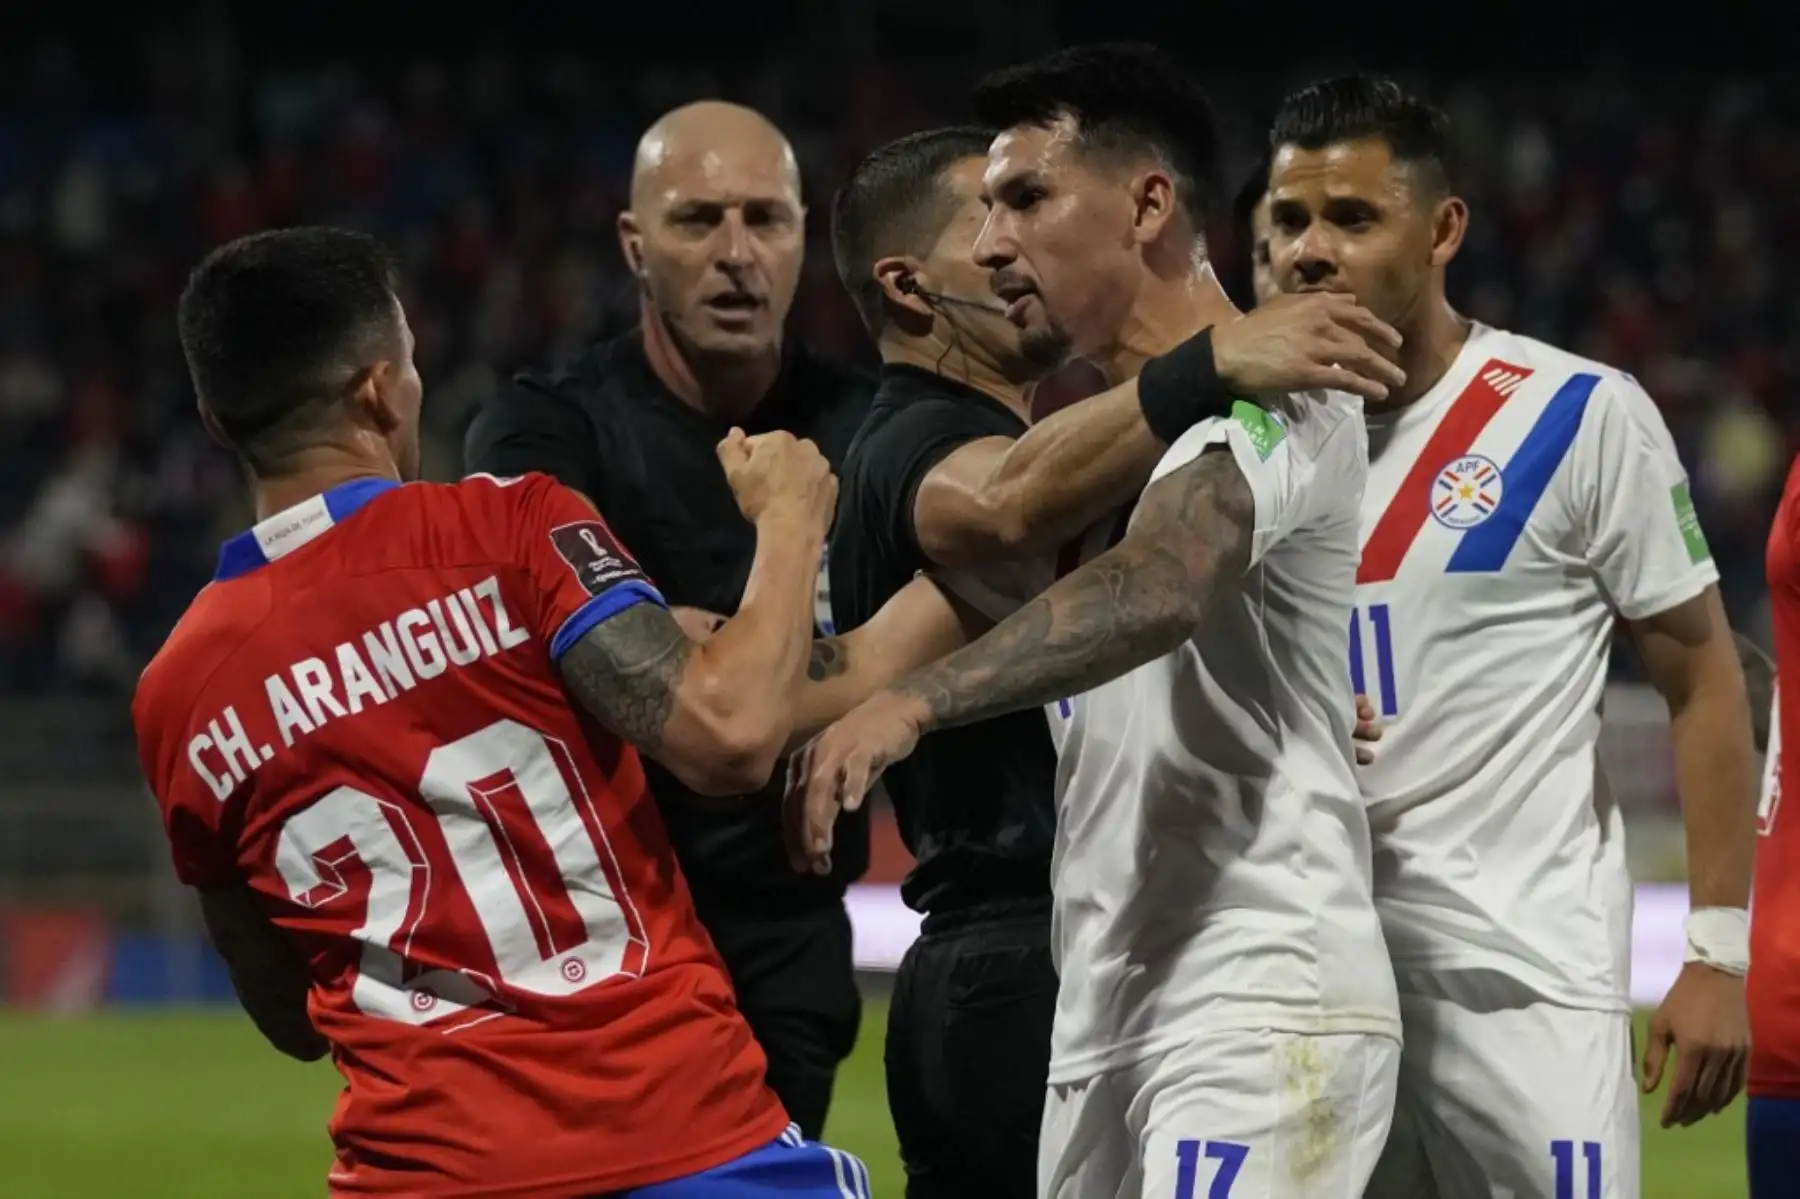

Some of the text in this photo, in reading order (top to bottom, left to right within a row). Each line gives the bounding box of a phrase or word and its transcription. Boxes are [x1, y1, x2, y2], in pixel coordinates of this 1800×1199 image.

[1455, 460, 1480, 474] APF
[187, 575, 530, 802] CH. ARANGUIZ
[274, 717, 650, 1027] 20
[1175, 1140, 1250, 1199] 17
[1551, 1140, 1602, 1199] 11
